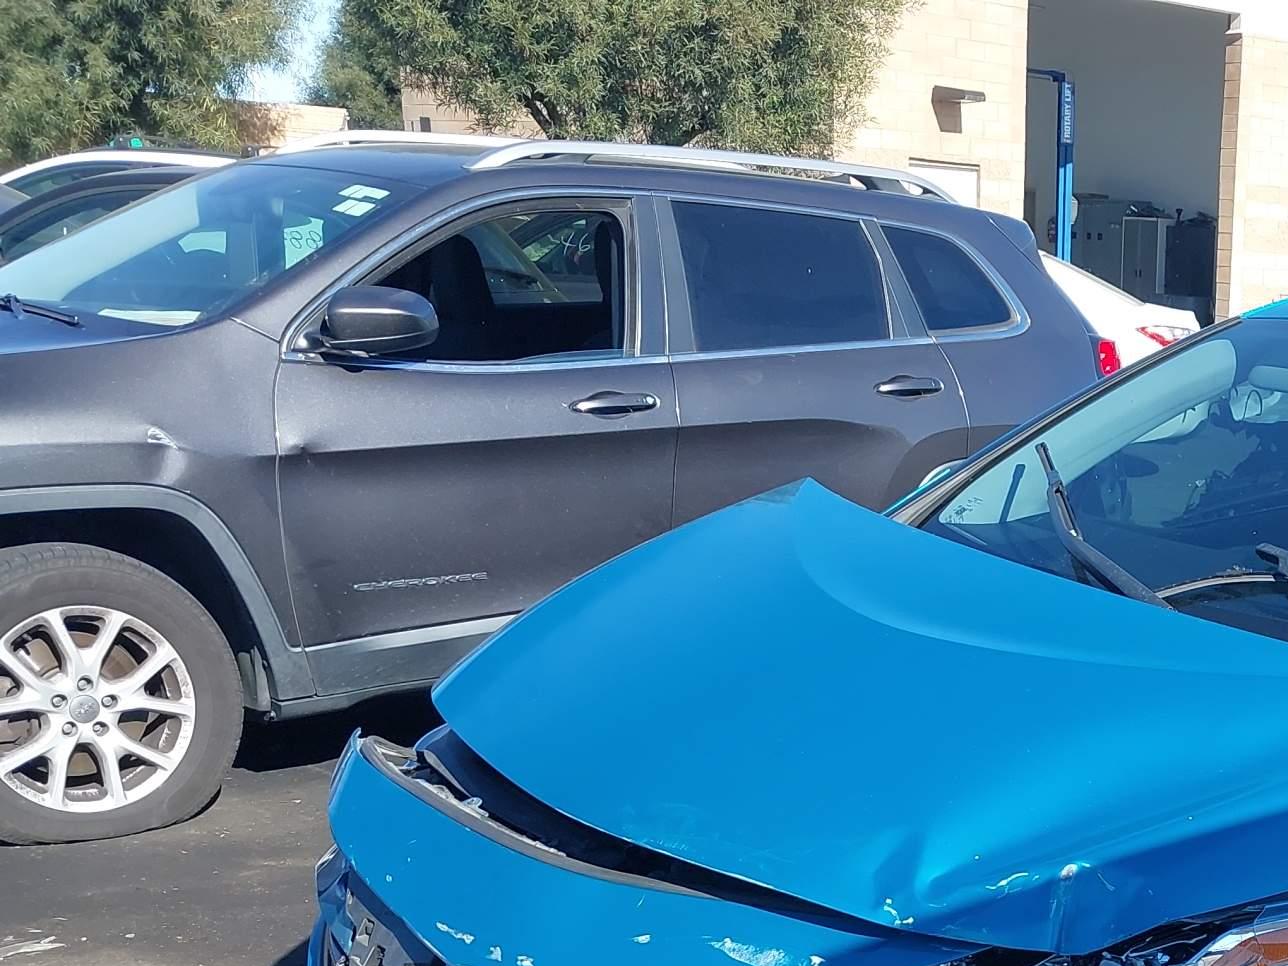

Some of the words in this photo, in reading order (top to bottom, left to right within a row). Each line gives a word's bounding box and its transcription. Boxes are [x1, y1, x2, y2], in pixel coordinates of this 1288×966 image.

[1064, 83, 1072, 101] LIFT
[1063, 104, 1072, 138] ROTARY
[353, 571, 489, 591] CHEROKEE
